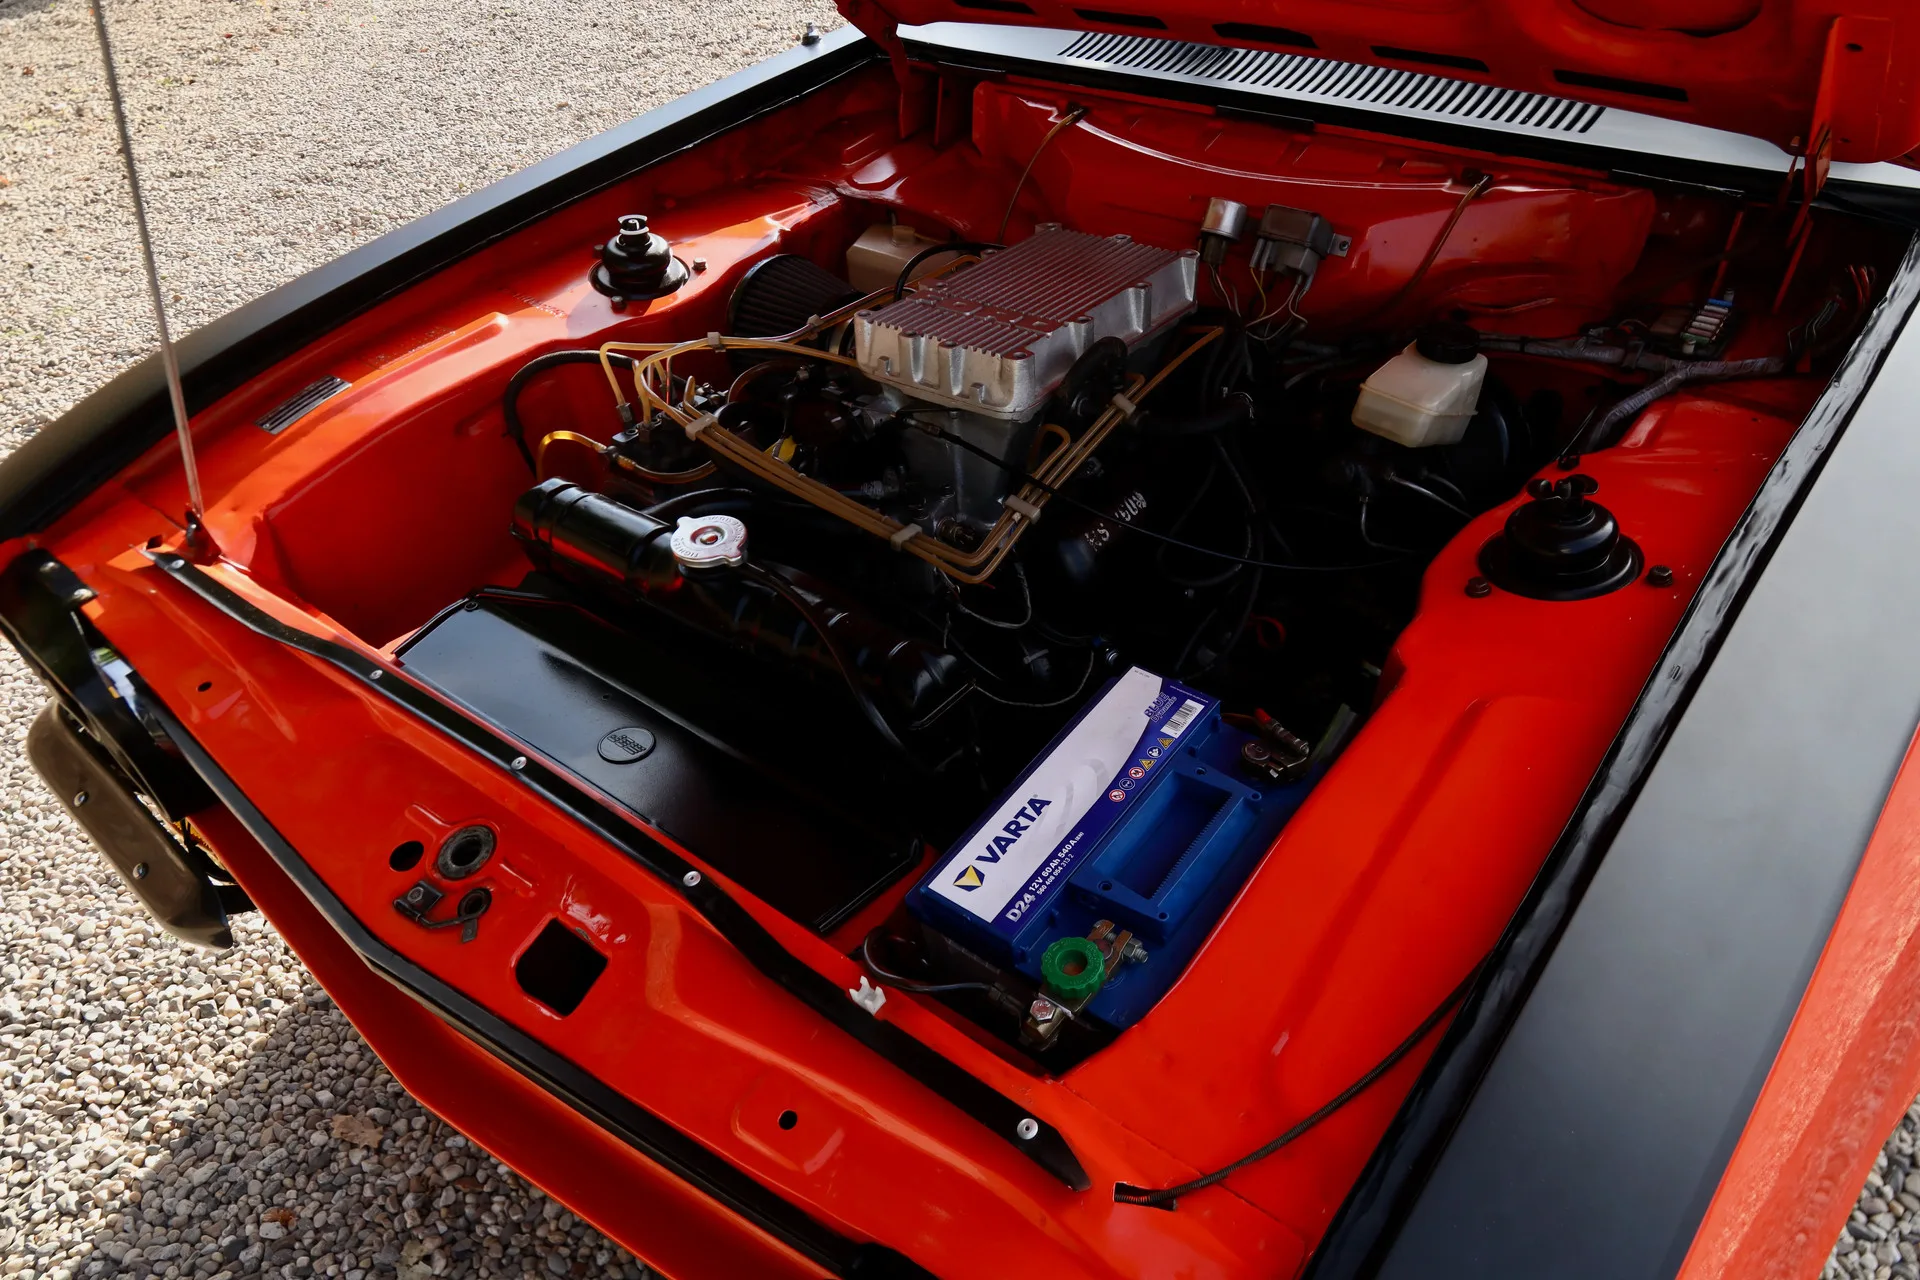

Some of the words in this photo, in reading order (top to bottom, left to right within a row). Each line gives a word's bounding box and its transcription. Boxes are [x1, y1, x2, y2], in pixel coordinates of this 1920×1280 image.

[1143, 691, 1171, 718] BLUE
[975, 798, 1052, 863] VARTA
[1005, 892, 1036, 922] D24
[1029, 876, 1043, 892] 12V
